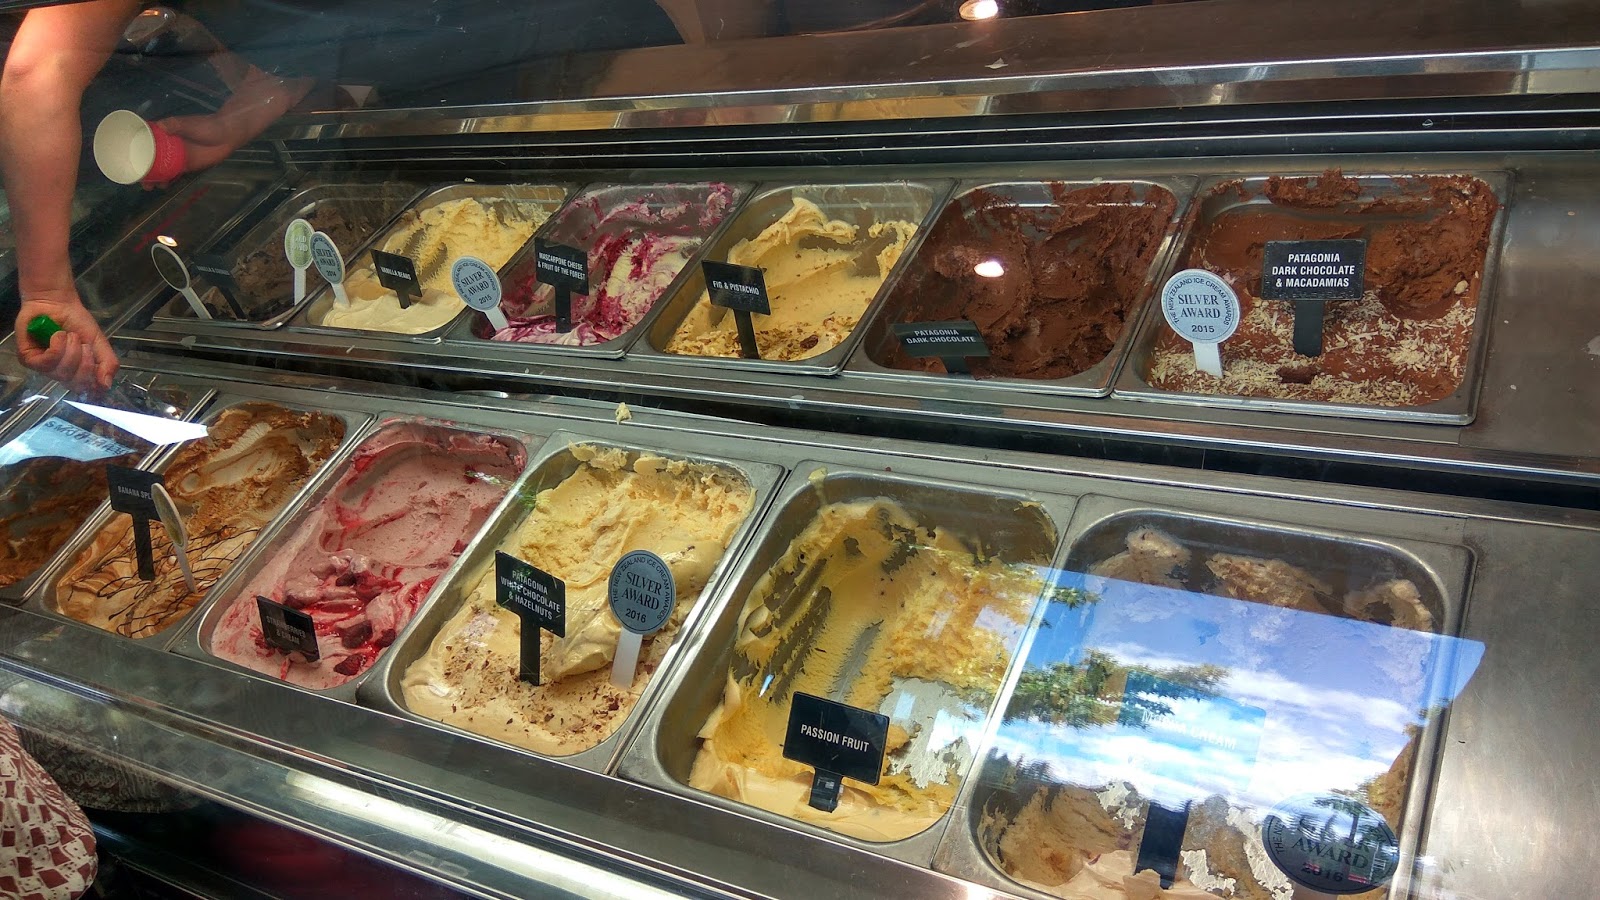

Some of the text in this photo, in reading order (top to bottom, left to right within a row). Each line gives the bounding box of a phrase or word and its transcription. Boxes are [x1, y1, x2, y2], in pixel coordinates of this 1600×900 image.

[316, 248, 333, 258] SILVER
[1287, 253, 1341, 263] PATAGONIA
[538, 252, 584, 271] MASCARPONE CHEESE
[460, 270, 485, 287] SILVER
[542, 262, 554, 271] FRUIT
[554, 265, 561, 273] OF
[561, 267, 569, 276] THE
[569, 269, 586, 281] FOREST
[1271, 265, 1356, 276] DARK CHOCOLATE
[467, 280, 490, 296] AWARD
[712, 280, 760, 296] FIG & PISTACHIO
[1170, 278, 1193, 297] ZEALAND
[1193, 277, 1205, 285] ICE
[1275, 277, 1350, 288] & MACADAMIAS
[1205, 280, 1227, 299] CREAM
[478, 294, 493, 305] 2015
[1177, 294, 1220, 306] SILVER
[1170, 312, 1180, 324] THE
[1180, 307, 1221, 319] AWARD
[1223, 299, 1232, 326] AWARDS
[914, 329, 960, 337] PATAGONIA
[1191, 324, 1215, 333] 2015
[906, 336, 977, 345] DARK CHOCOLATE
[117, 485, 152, 500] BANANA SPL
[620, 557, 646, 572] ZEALAND
[646, 558, 657, 568] ICE
[512, 570, 548, 595] PATAGONIA
[614, 571, 622, 587] NEW
[625, 571, 662, 595] SILVER
[655, 565, 670, 590] CREAM
[500, 576, 561, 613] WHITE CHOCOLATE
[621, 587, 660, 610] AWARD
[508, 591, 553, 621] & HAZELNUTS
[657, 591, 670, 620] AWARDS
[625, 608, 647, 623] 2016
[800, 724, 870, 753] PASSION FRUIT
[1291, 837, 1370, 869] AWARD
